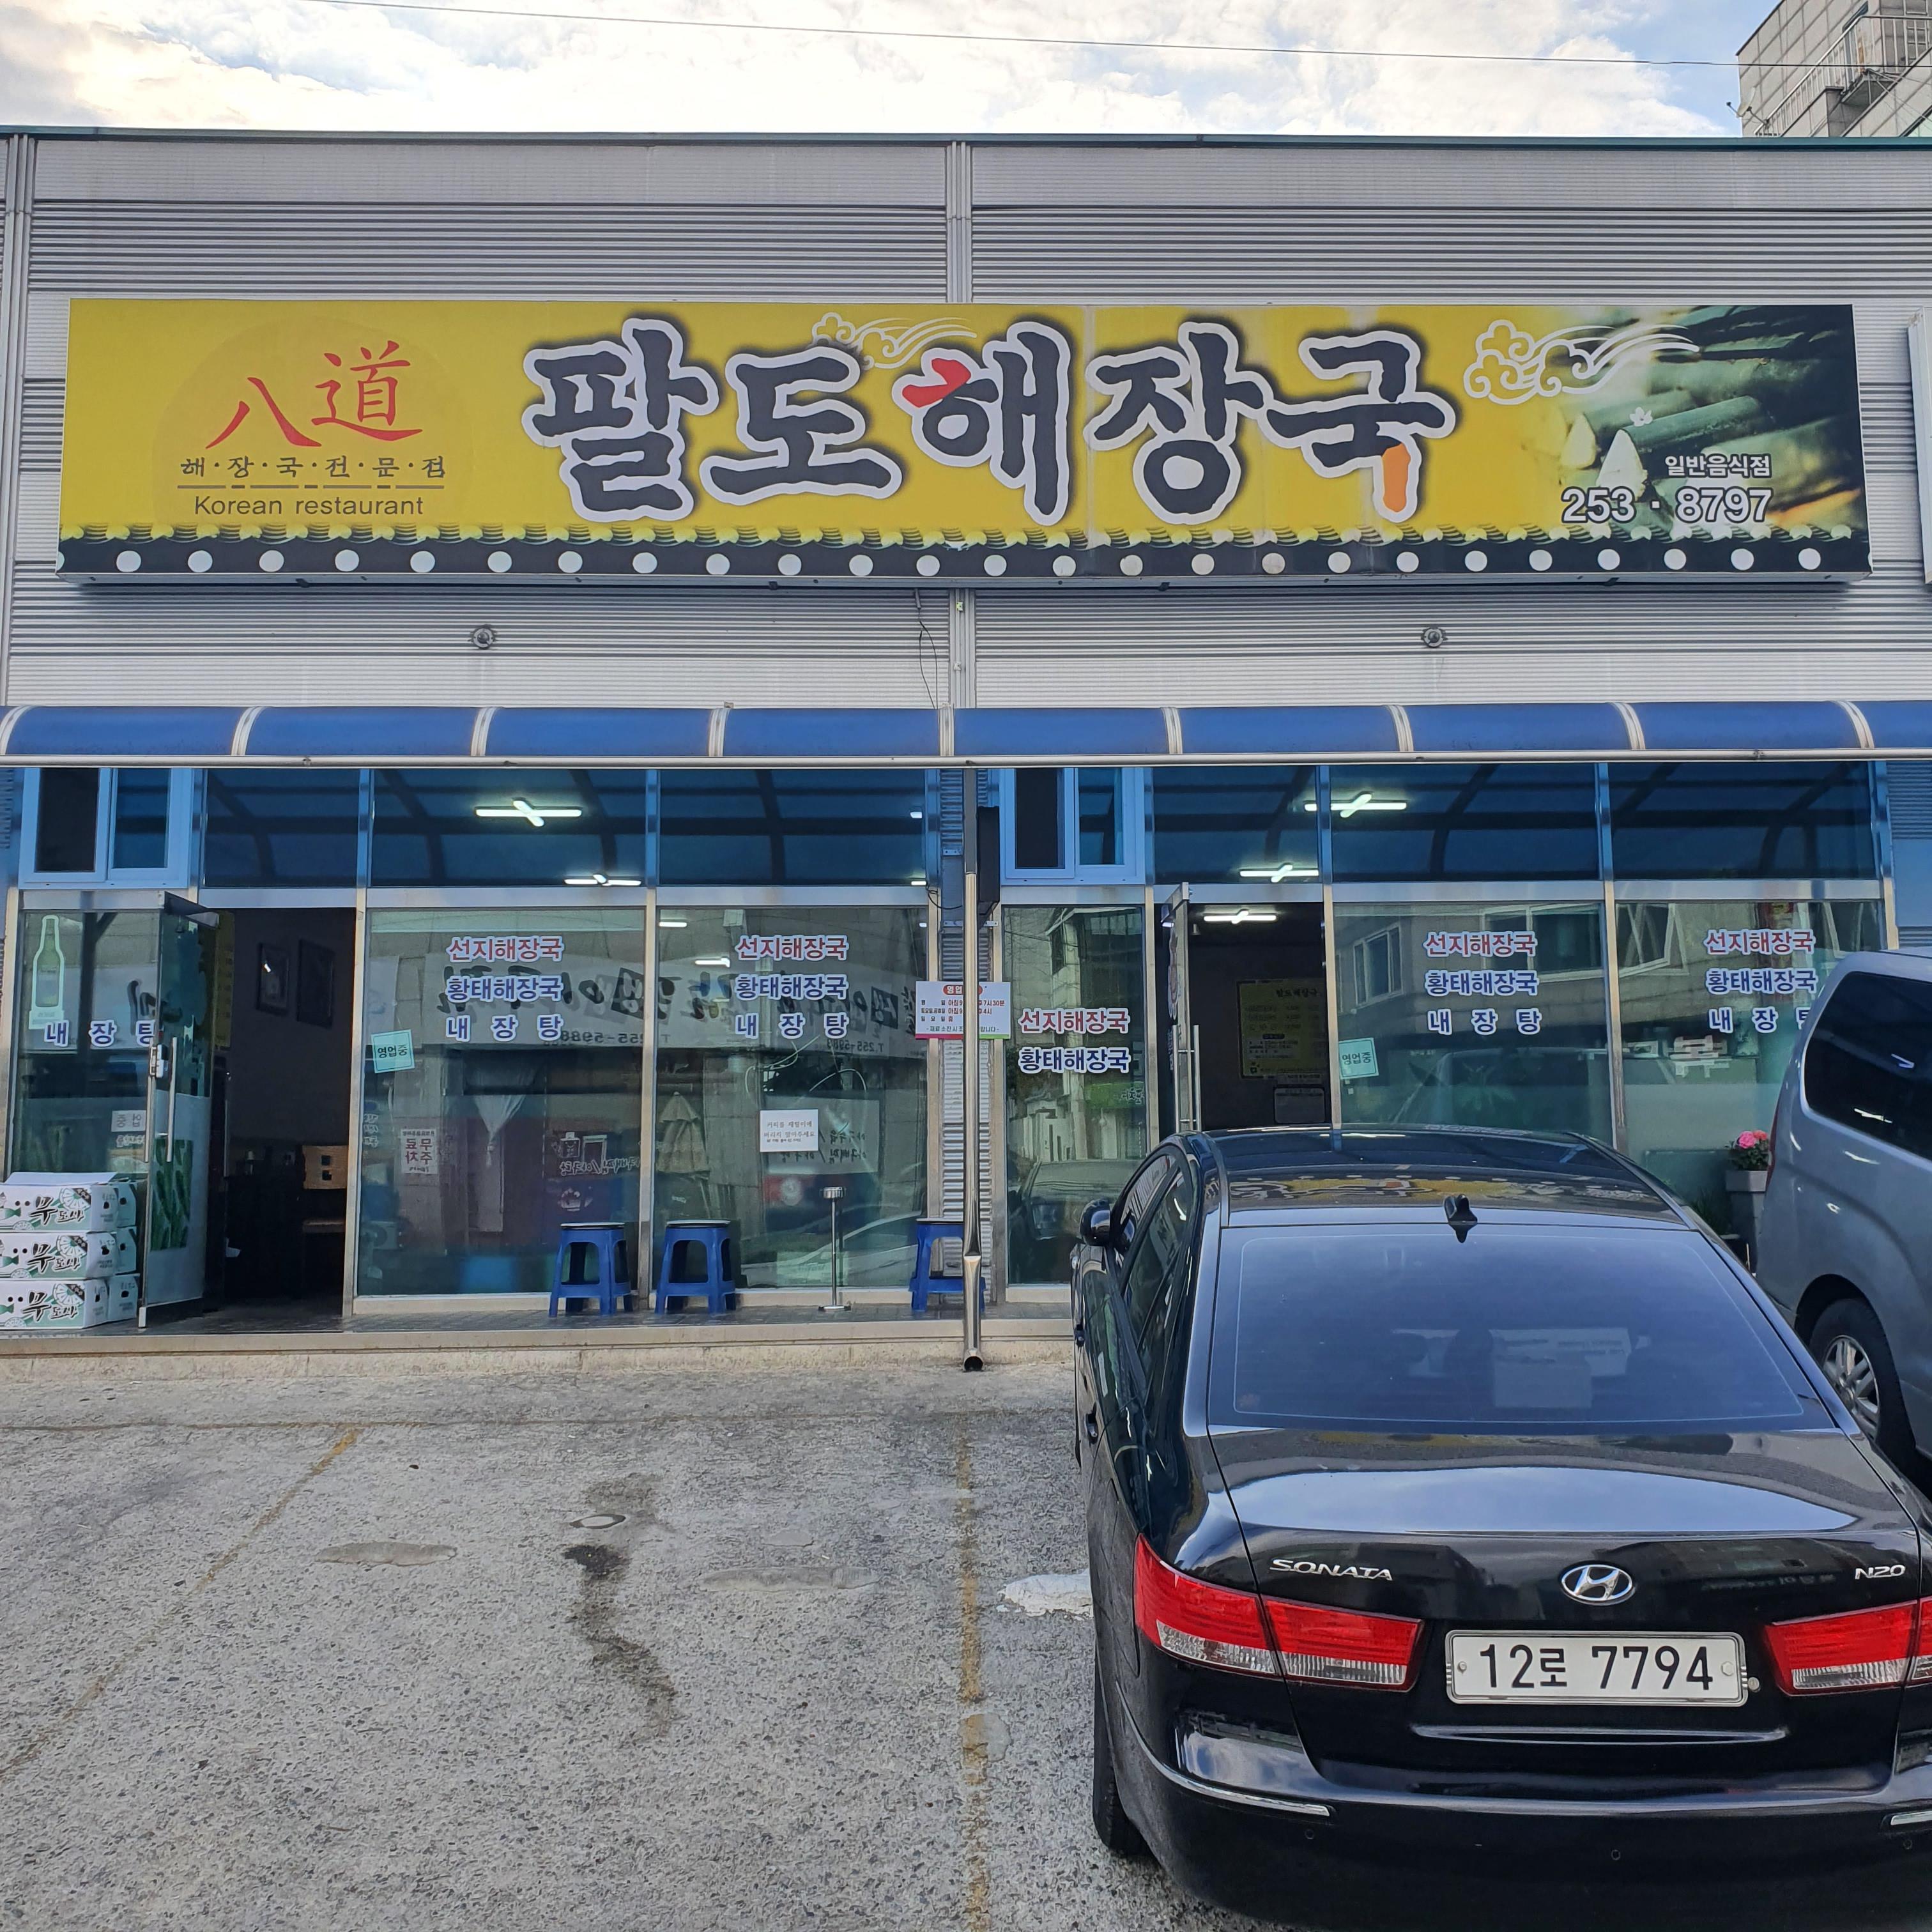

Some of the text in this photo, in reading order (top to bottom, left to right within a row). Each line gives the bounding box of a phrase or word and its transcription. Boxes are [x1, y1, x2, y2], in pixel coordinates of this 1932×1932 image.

[206, 341, 423, 449] 八道
[525, 319, 1453, 524] 팔도해장국
[1665, 455, 1772, 477] 일반음식점
[195, 496, 423, 515] Korean restaurant
[1562, 486, 1772, 523] 253 8797
[446, 935, 564, 962] 선지해장국
[735, 935, 848, 961] 선지해장국
[1422, 931, 1538, 957] 선지해장국
[1703, 929, 1816, 954] 선지해장국
[446, 975, 564, 1003] 황태해장국
[735, 974, 848, 1000] 황태해장국
[1425, 970, 1539, 996] 황태해장국
[1706, 968, 1816, 994] 황태해장국
[1018, 1008, 1130, 1034] 선지해장국
[377, 1045, 408, 1059] 영업중
[1018, 1047, 1131, 1073] 황태해장국
[1342, 1051, 1372, 1065] 영업중
[1269, 1558, 1906, 1581] SONATA N20
[1480, 1644, 1713, 1691] 12로 7794
